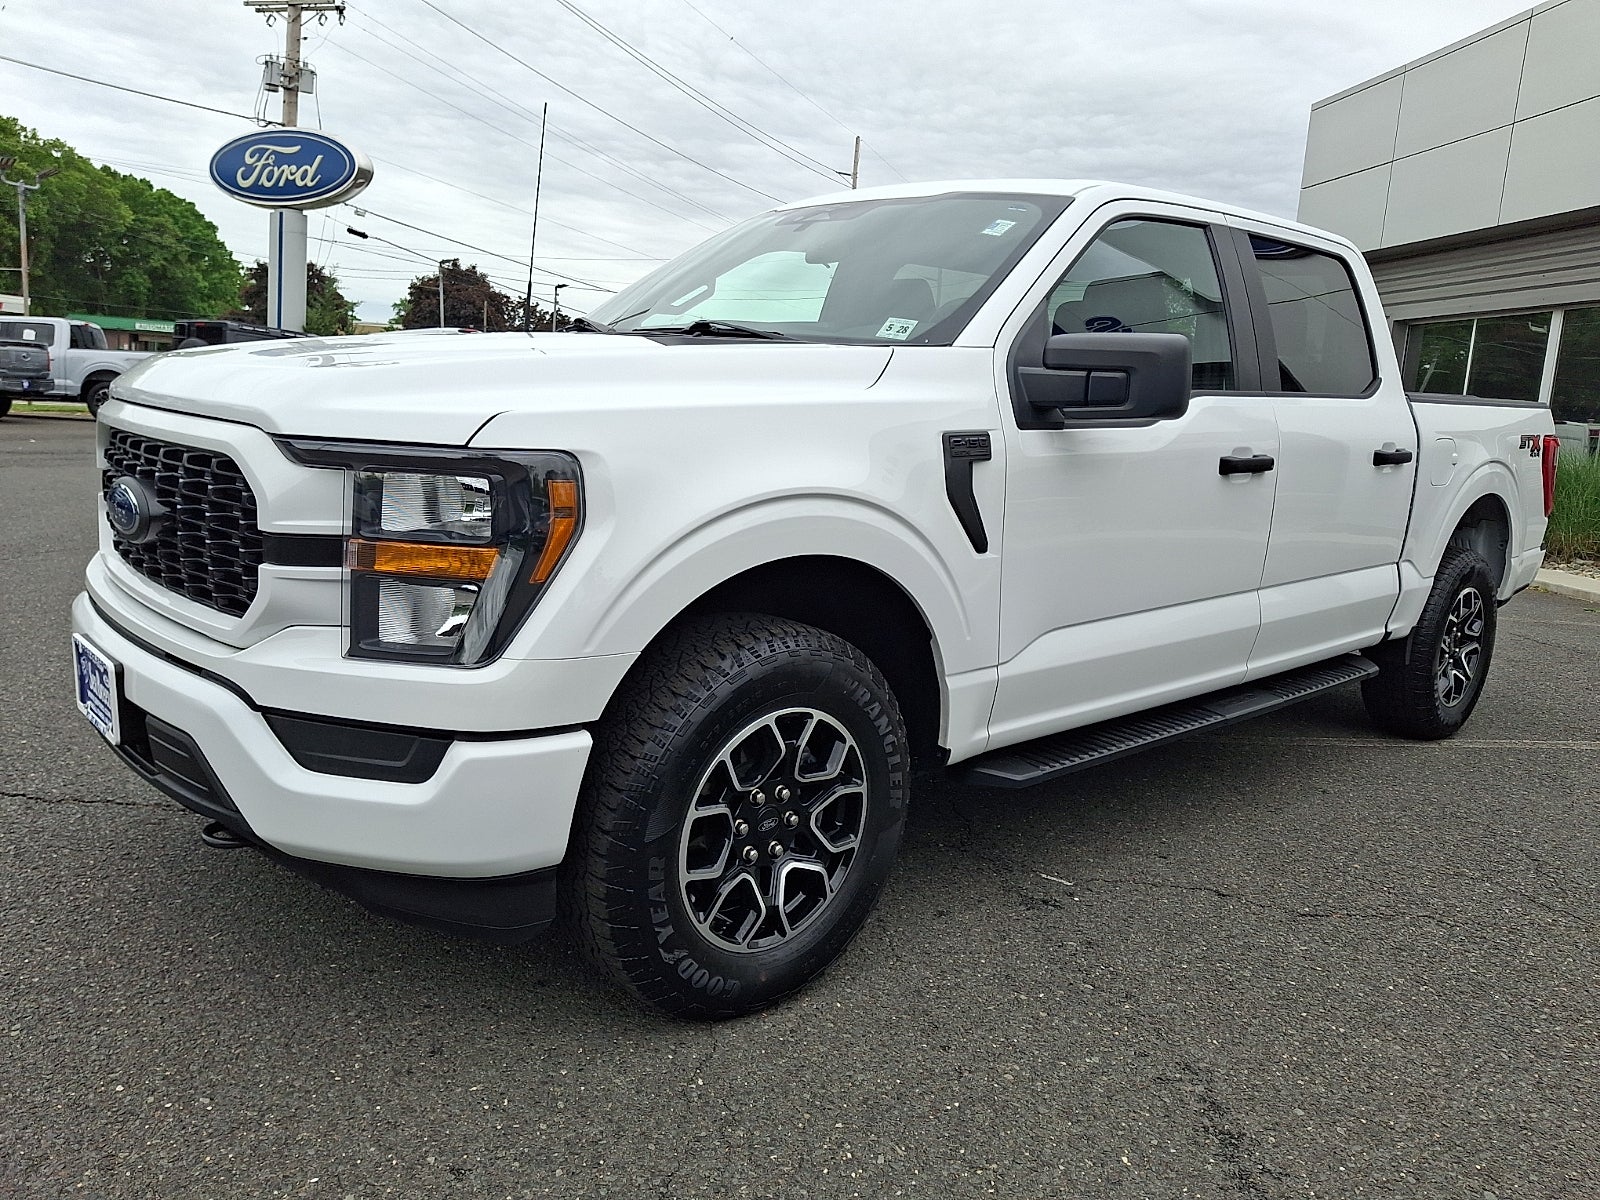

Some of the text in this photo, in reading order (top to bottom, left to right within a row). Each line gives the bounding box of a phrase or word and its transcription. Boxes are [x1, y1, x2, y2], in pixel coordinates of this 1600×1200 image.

[236, 144, 324, 188] Ford
[886, 323, 910, 334] 5 28
[1519, 434, 1541, 452] STX
